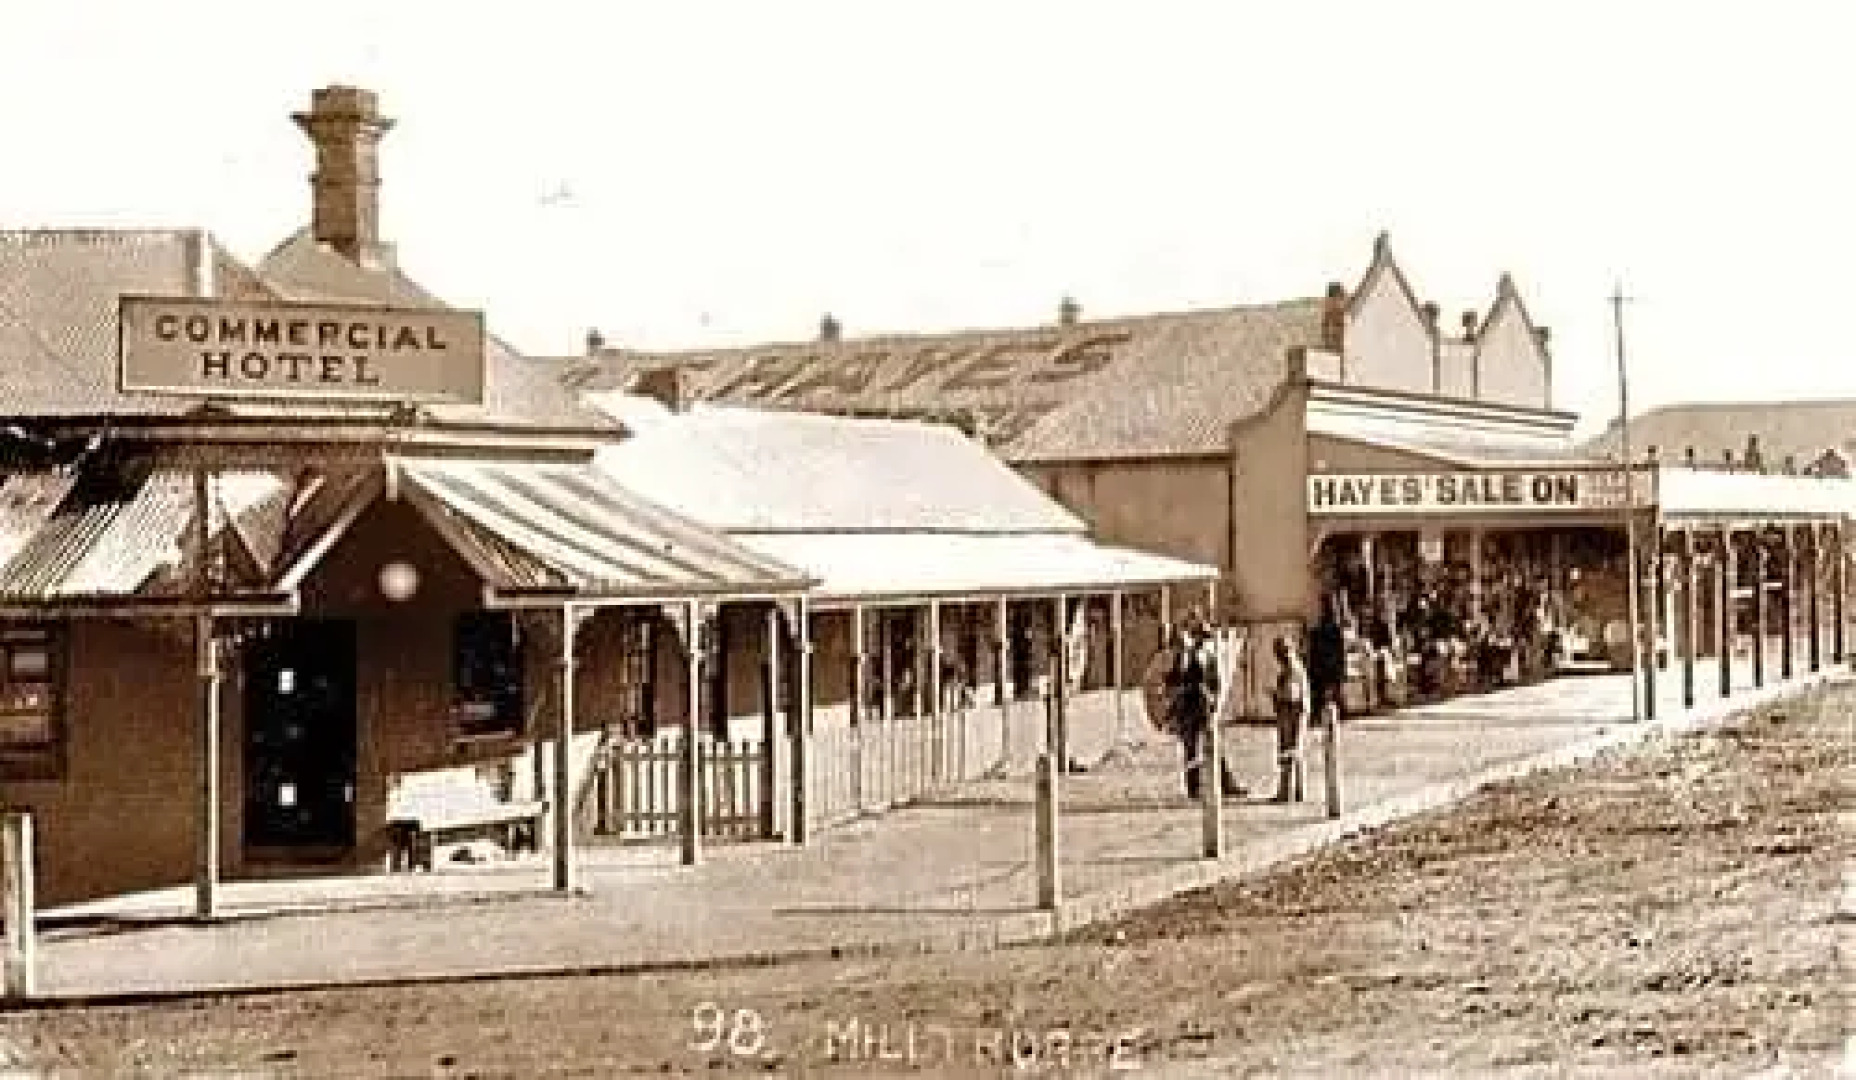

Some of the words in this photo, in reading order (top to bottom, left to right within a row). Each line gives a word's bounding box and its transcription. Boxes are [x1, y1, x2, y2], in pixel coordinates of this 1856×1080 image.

[154, 314, 447, 350] COMMERCIAL
[202, 351, 380, 386] HOTEL
[1436, 475, 1525, 506] SALE
[1531, 474, 1578, 505] ON
